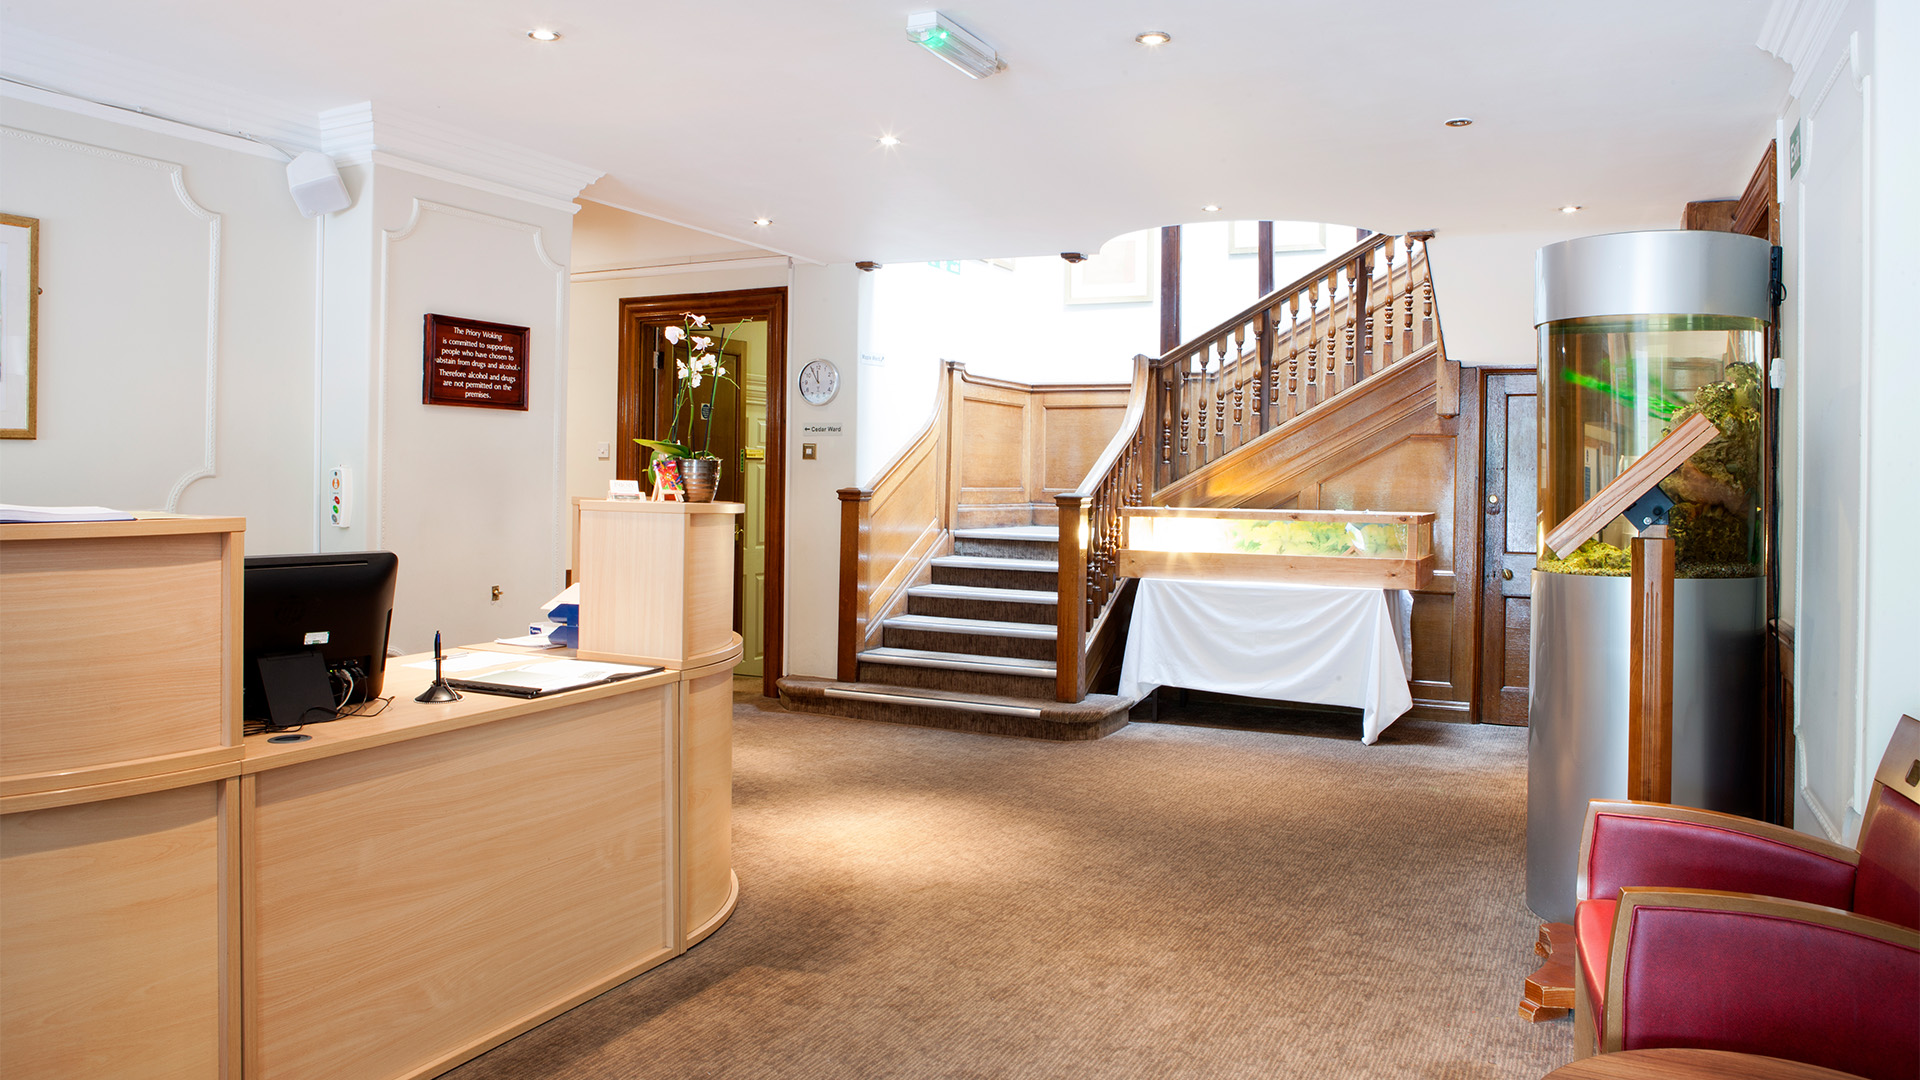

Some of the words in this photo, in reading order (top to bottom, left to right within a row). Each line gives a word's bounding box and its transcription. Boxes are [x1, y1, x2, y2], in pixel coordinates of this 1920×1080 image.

[453, 327, 464, 335] The
[465, 328, 481, 338] Priory
[482, 331, 503, 342] Woking
[448, 339, 478, 348] committed
[486, 343, 514, 353] supporting
[488, 352, 507, 360] chosen
[471, 360, 486, 369] drugs
[498, 363, 519, 371] alcohol.
[439, 369, 466, 378] Therefore
[467, 371, 488, 380] alcohol
[489, 373, 500, 381] and
[500, 374, 516, 384] drugs
[464, 391, 492, 399] premises.
